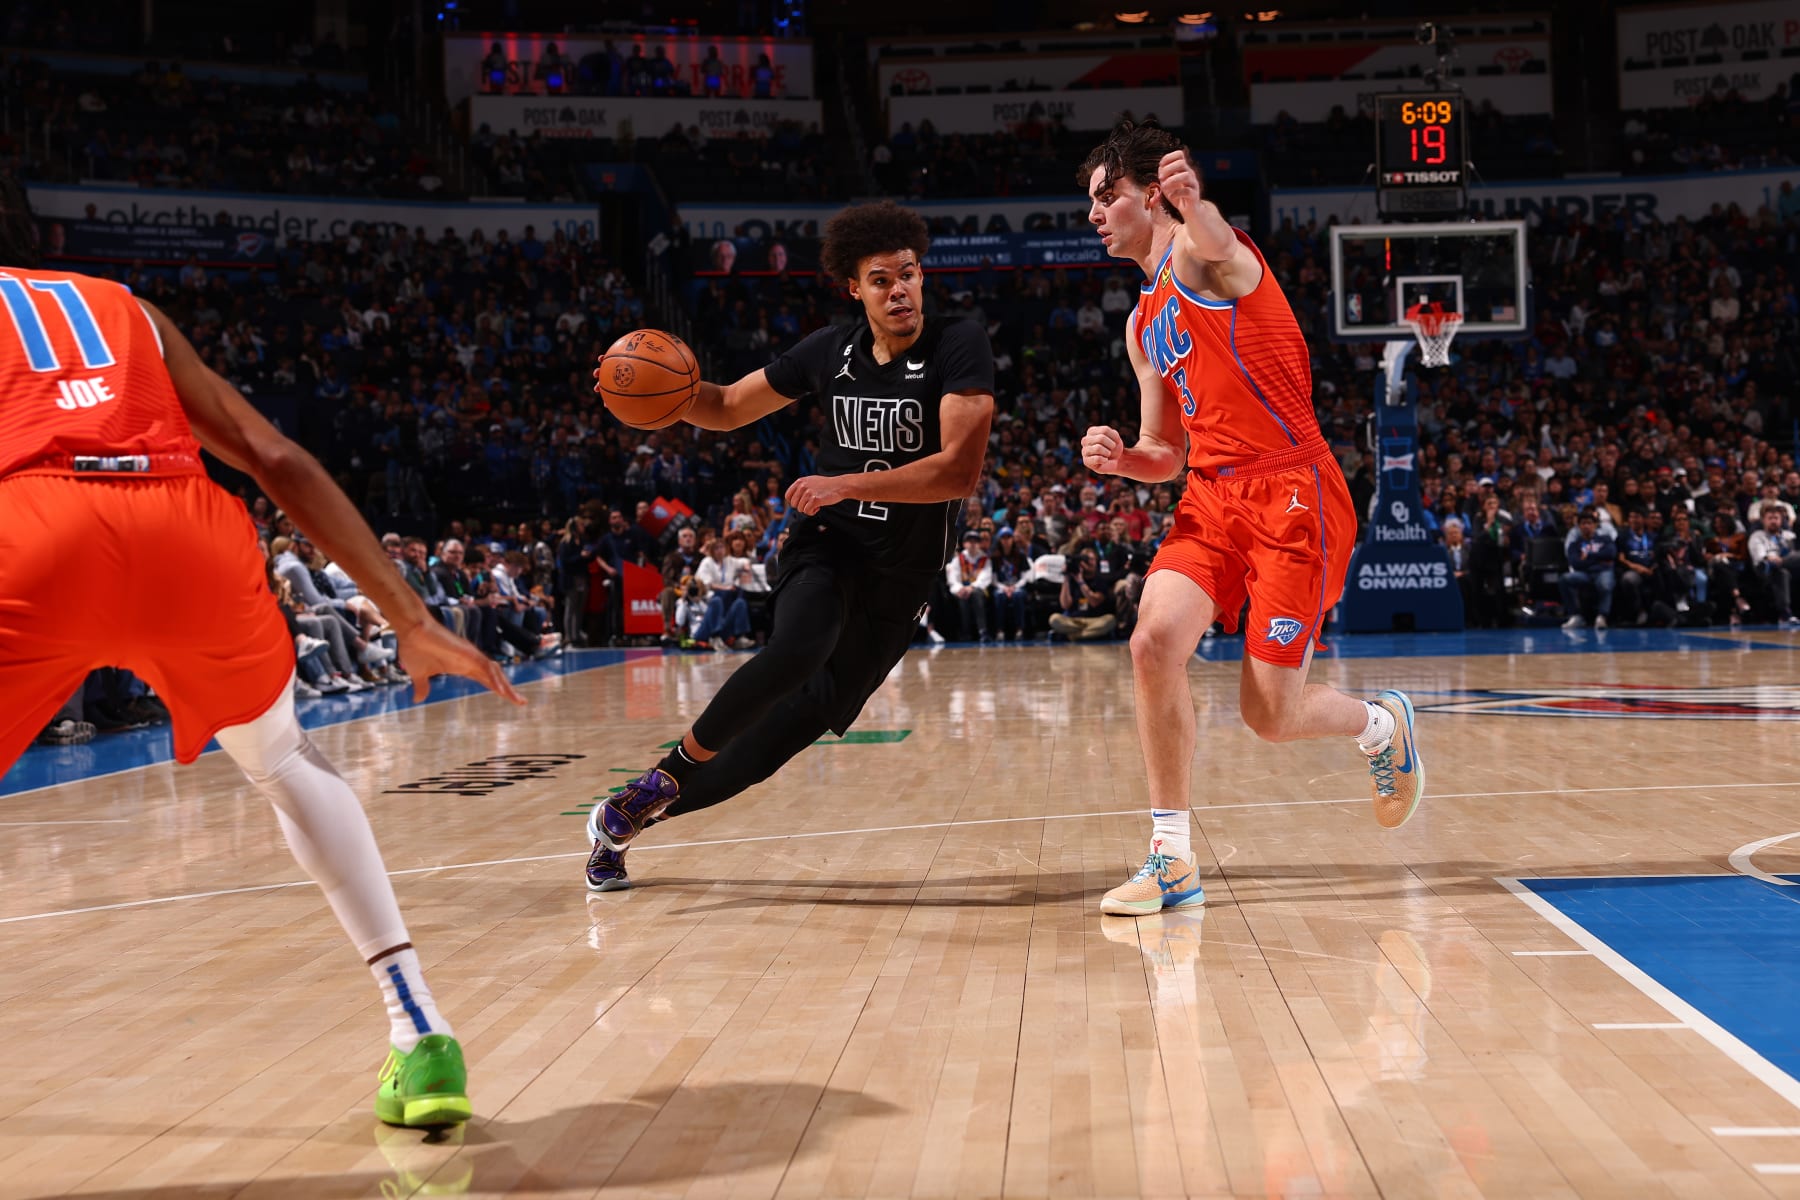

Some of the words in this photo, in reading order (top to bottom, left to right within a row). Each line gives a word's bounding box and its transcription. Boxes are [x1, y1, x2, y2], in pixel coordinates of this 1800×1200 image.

[1645, 29, 1699, 56] POST
[1733, 22, 1776, 49] OAK
[523, 106, 556, 126] POST
[579, 108, 607, 126] OAK
[699, 109, 731, 128] POST
[1401, 100, 1452, 126] 6:09
[1409, 124, 1448, 165] 19
[1404, 171, 1460, 184] TISSOT
[0, 272, 116, 372] 11
[1142, 295, 1193, 378] OKC
[843, 344, 854, 356] 6
[55, 377, 115, 410] JOE
[1171, 366, 1197, 416] 3
[832, 395, 924, 452] NETS
[1391, 501, 1410, 523] OU
[1376, 523, 1427, 541] Health
[1358, 562, 1448, 577] ALWAYS
[1358, 577, 1448, 590] ONWARD
